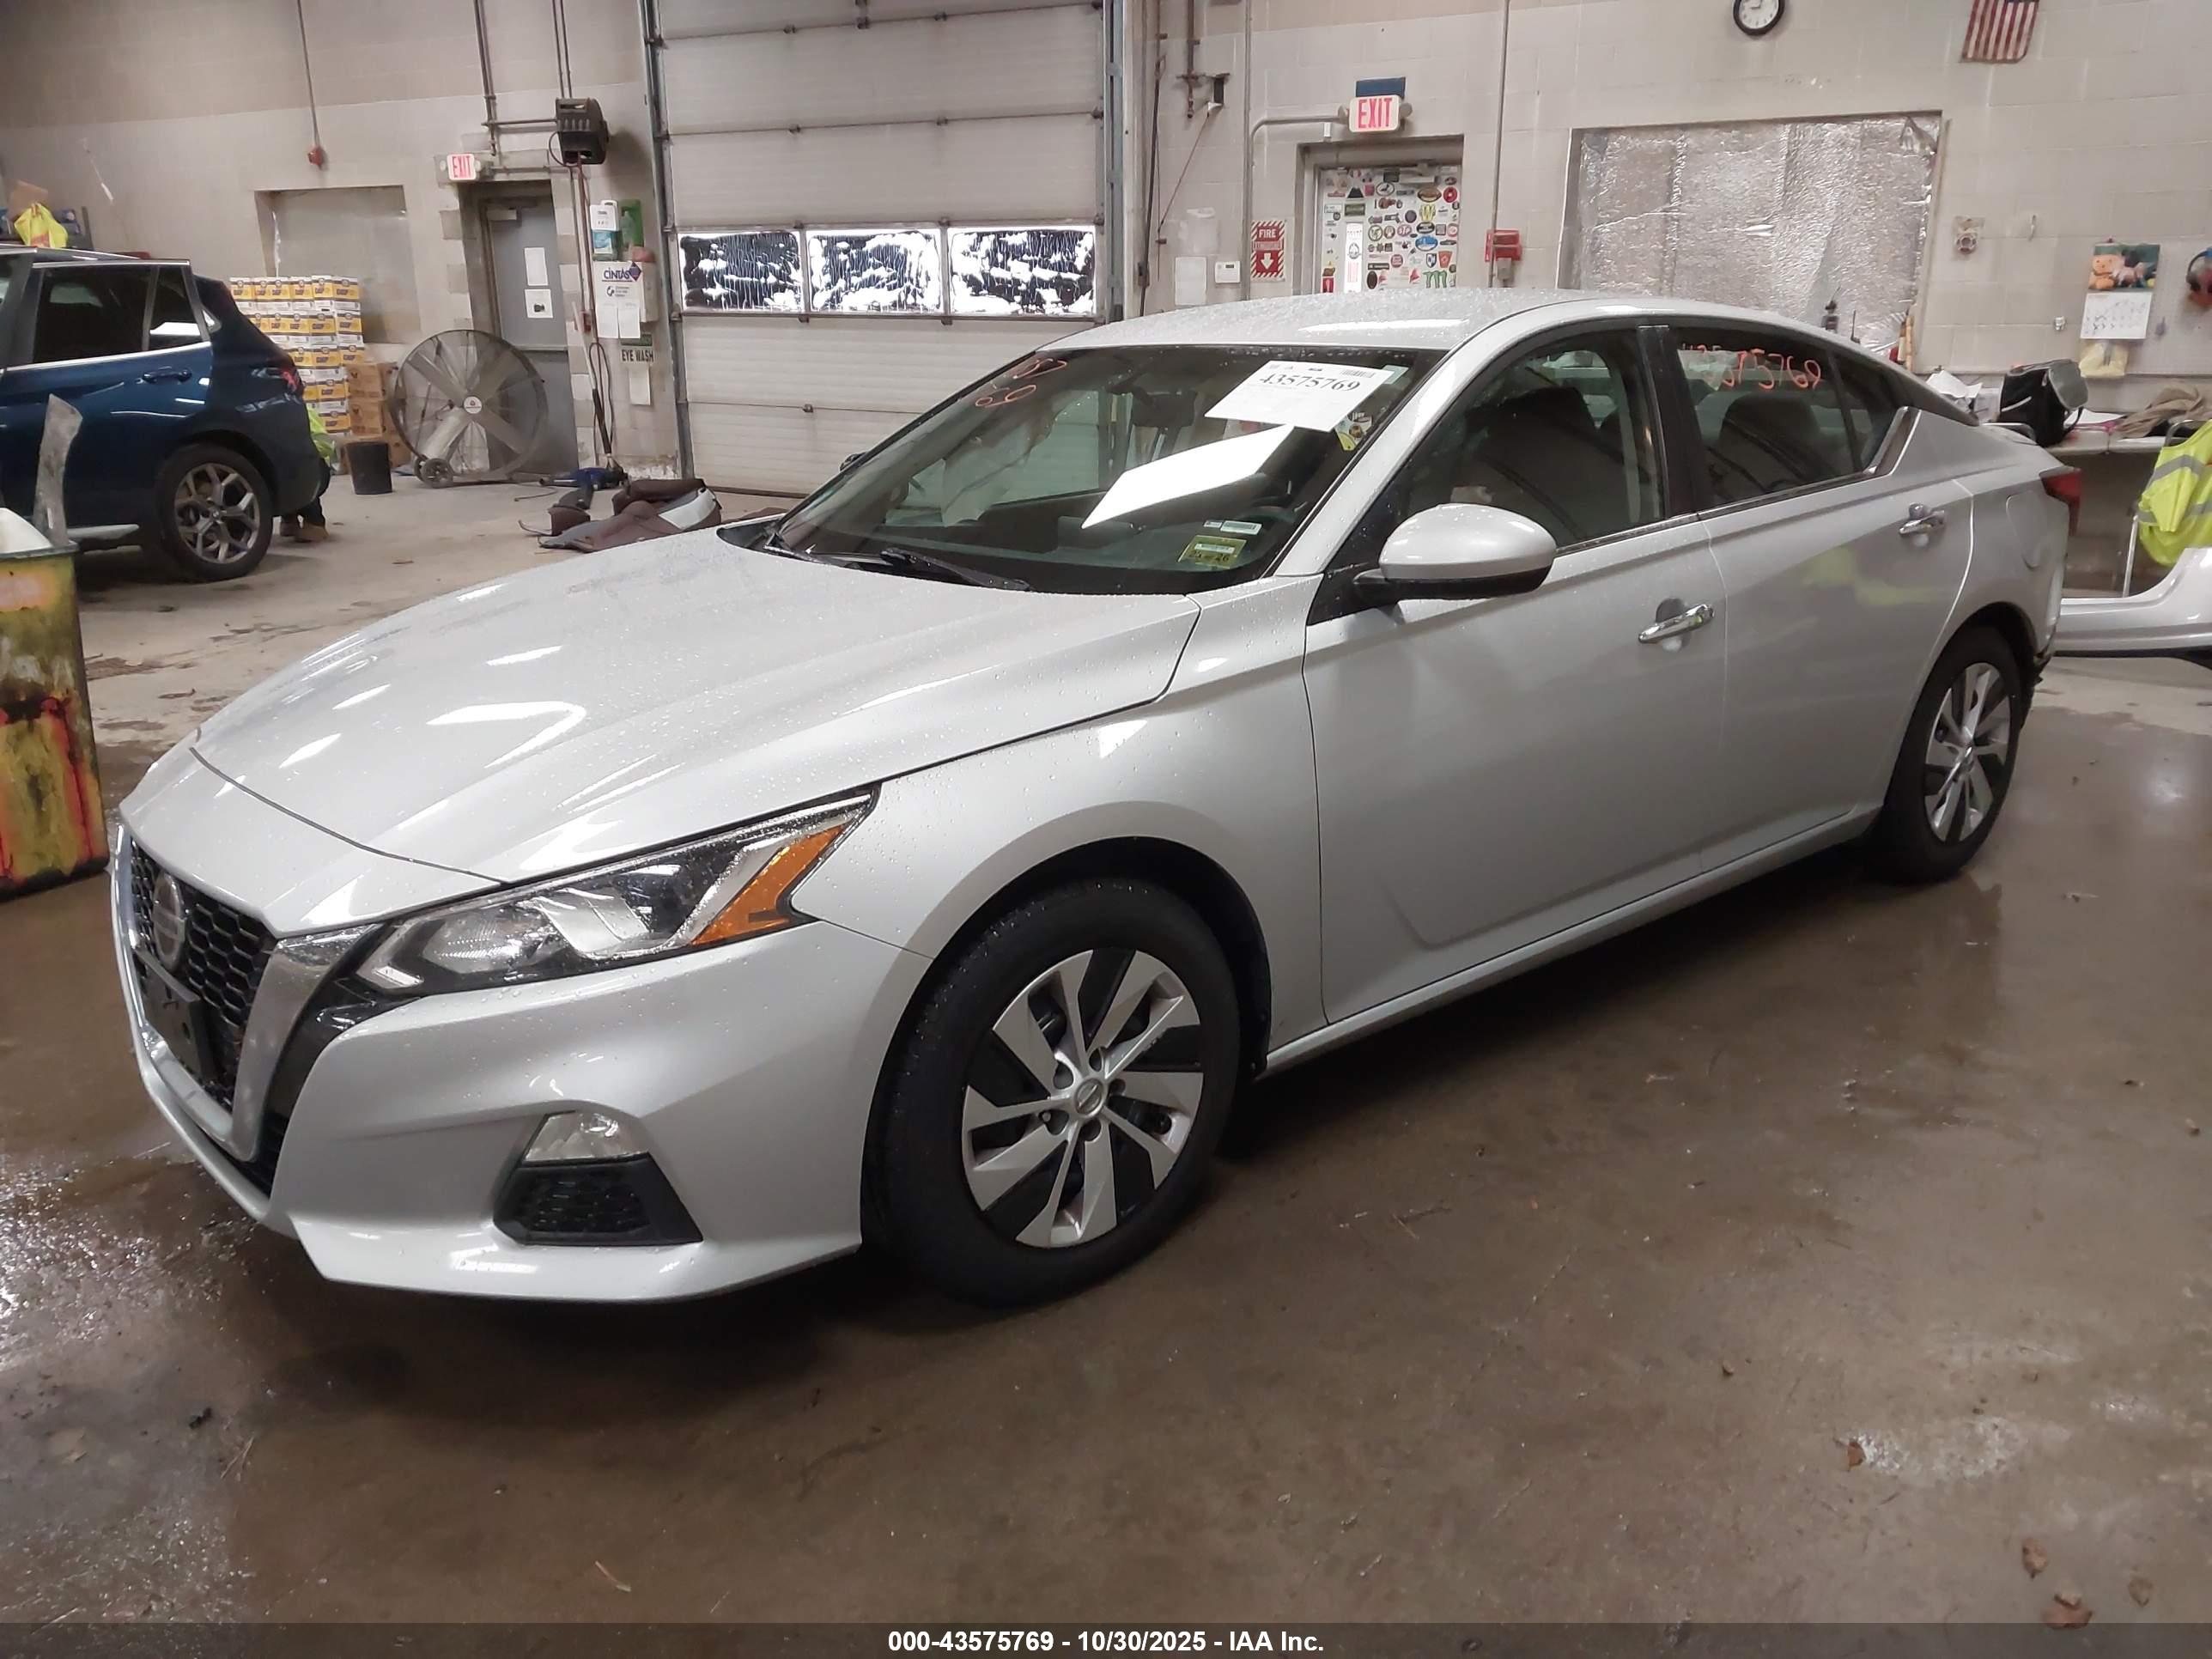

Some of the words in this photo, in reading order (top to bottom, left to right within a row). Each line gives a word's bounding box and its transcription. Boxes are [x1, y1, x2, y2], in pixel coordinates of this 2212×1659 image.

[1358, 97, 1393, 129] EXIT
[452, 155, 471, 178] EXIT
[1259, 228, 1277, 238] FIRE
[622, 349, 634, 362] EYE
[635, 349, 653, 362] WASH
[1259, 373, 1360, 392] 43575769
